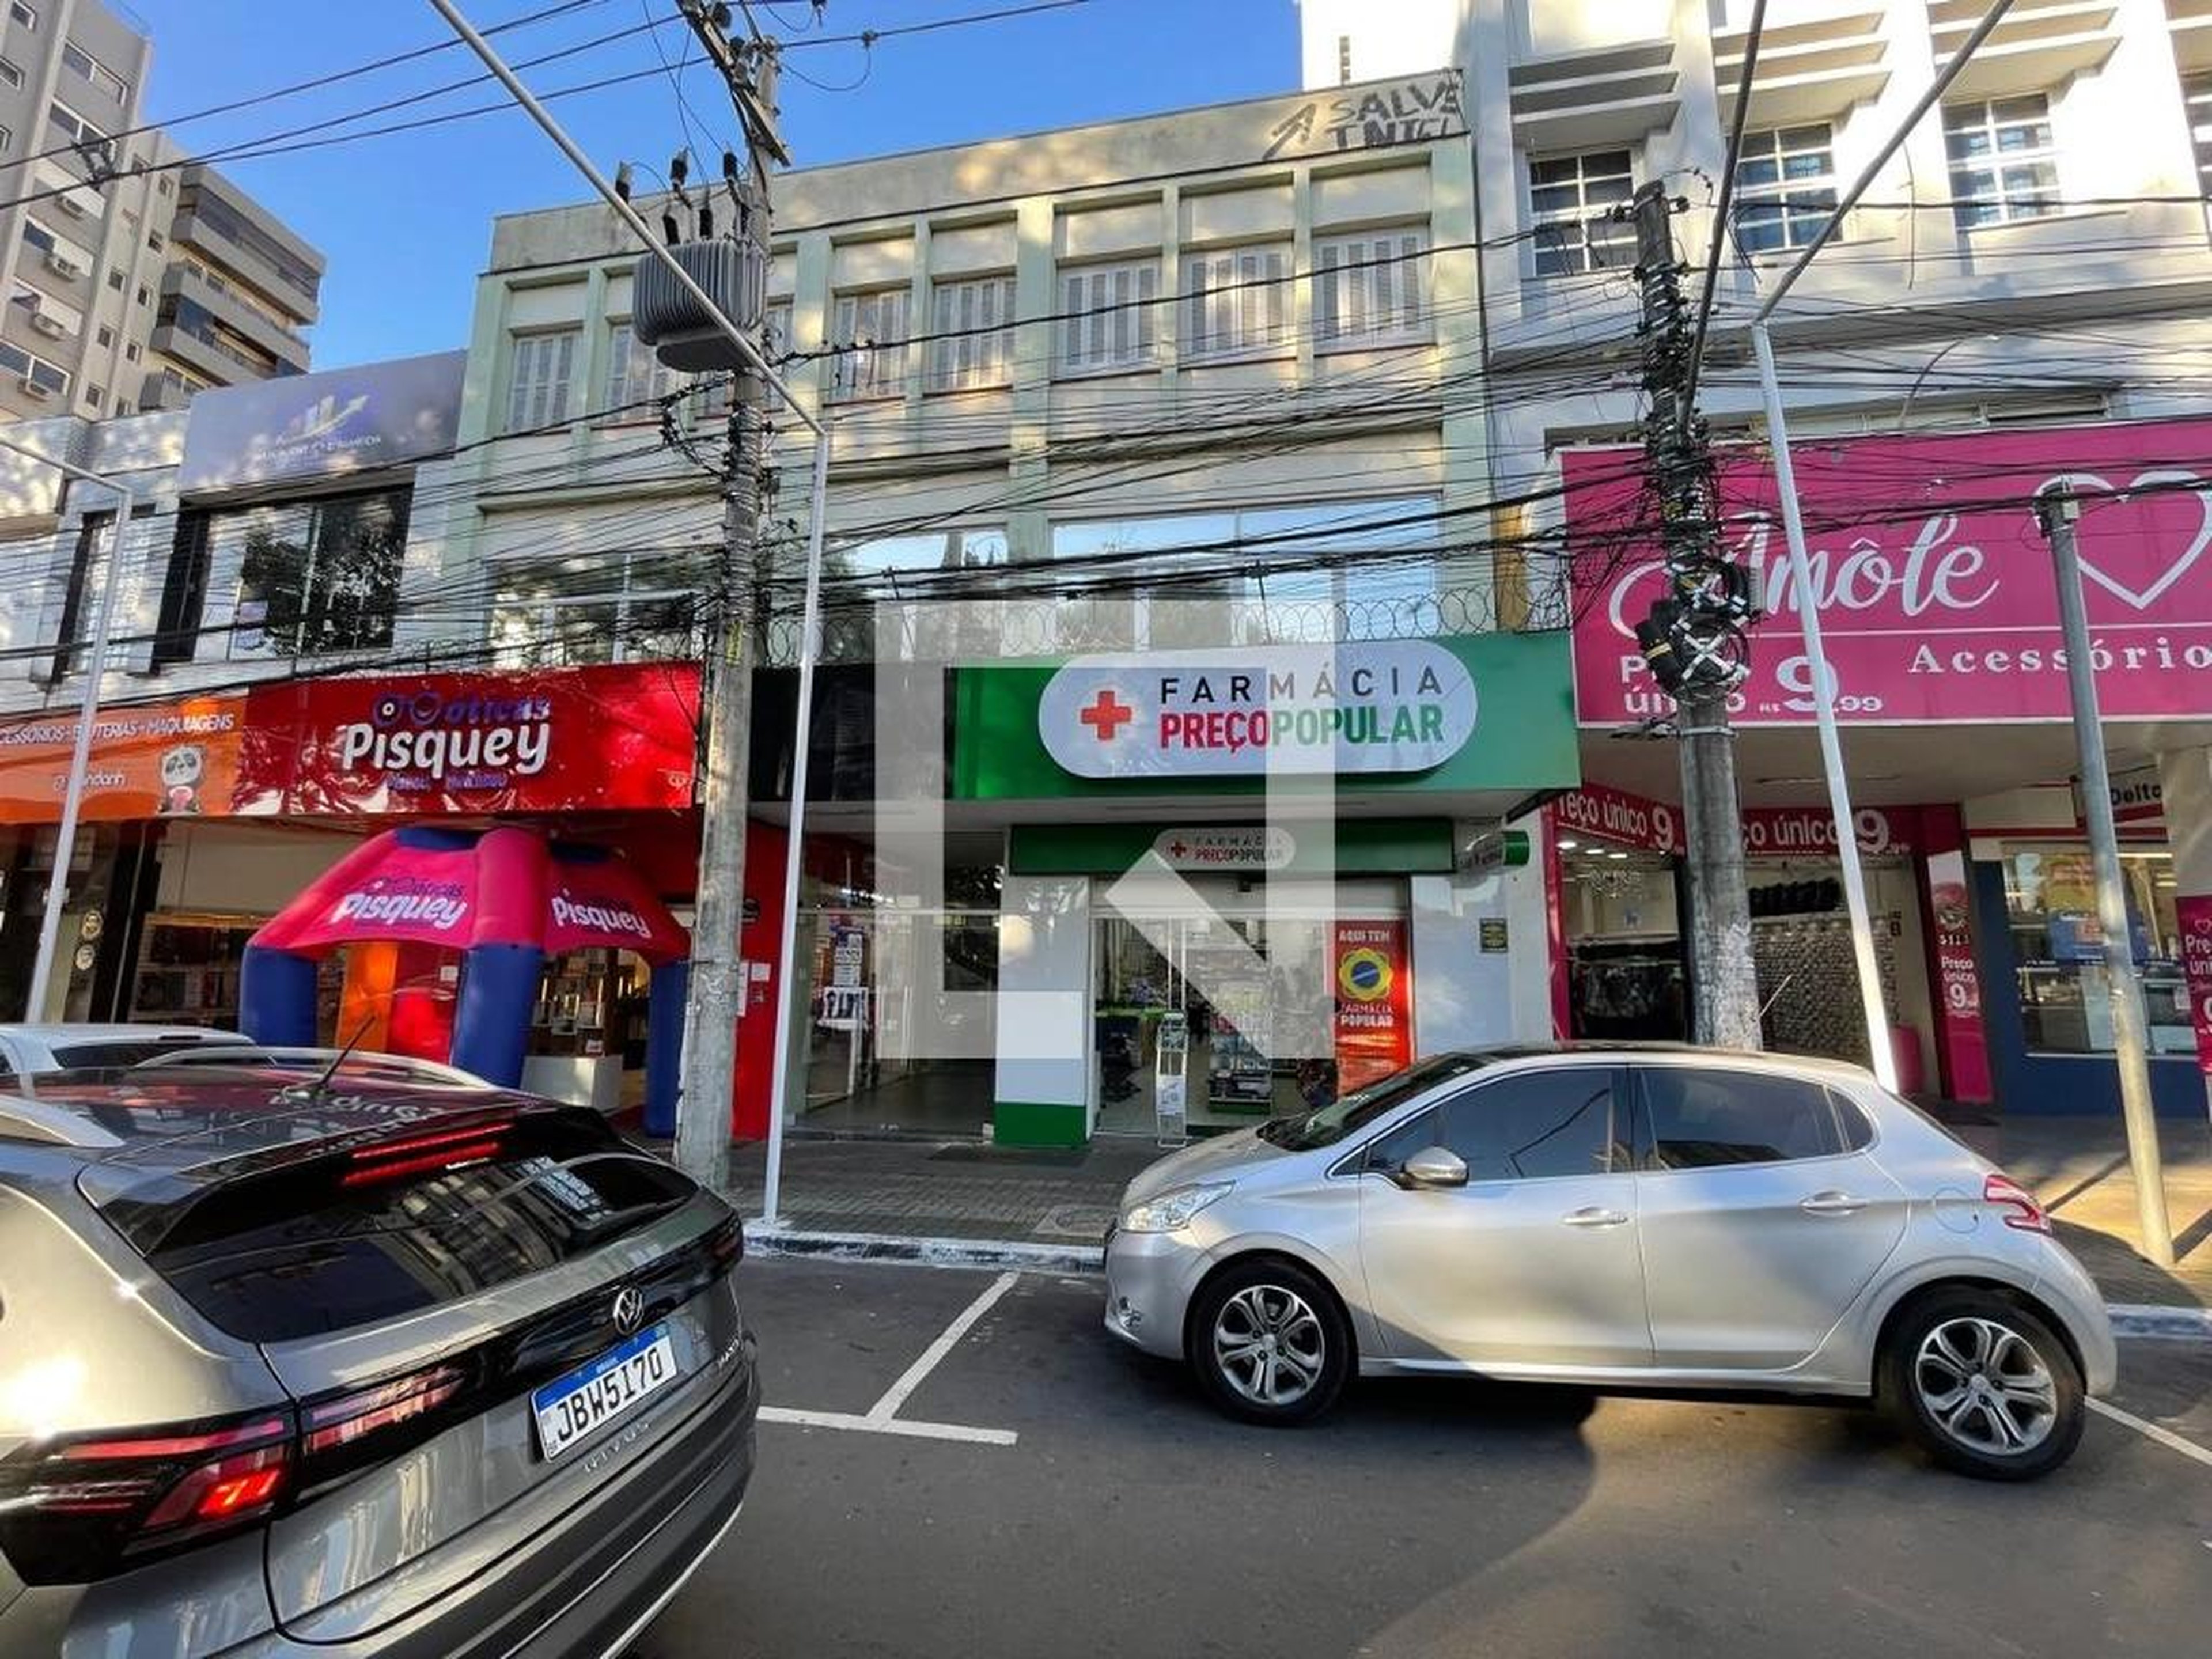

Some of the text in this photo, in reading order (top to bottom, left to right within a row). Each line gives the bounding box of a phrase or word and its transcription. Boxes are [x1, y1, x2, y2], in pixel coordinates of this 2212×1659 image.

[1161, 662, 1442, 704] FARMÁCIA
[342, 722, 550, 780] Pisquey
[334, 893, 468, 930] Pisquey
[551, 896, 653, 939] Pisquey
